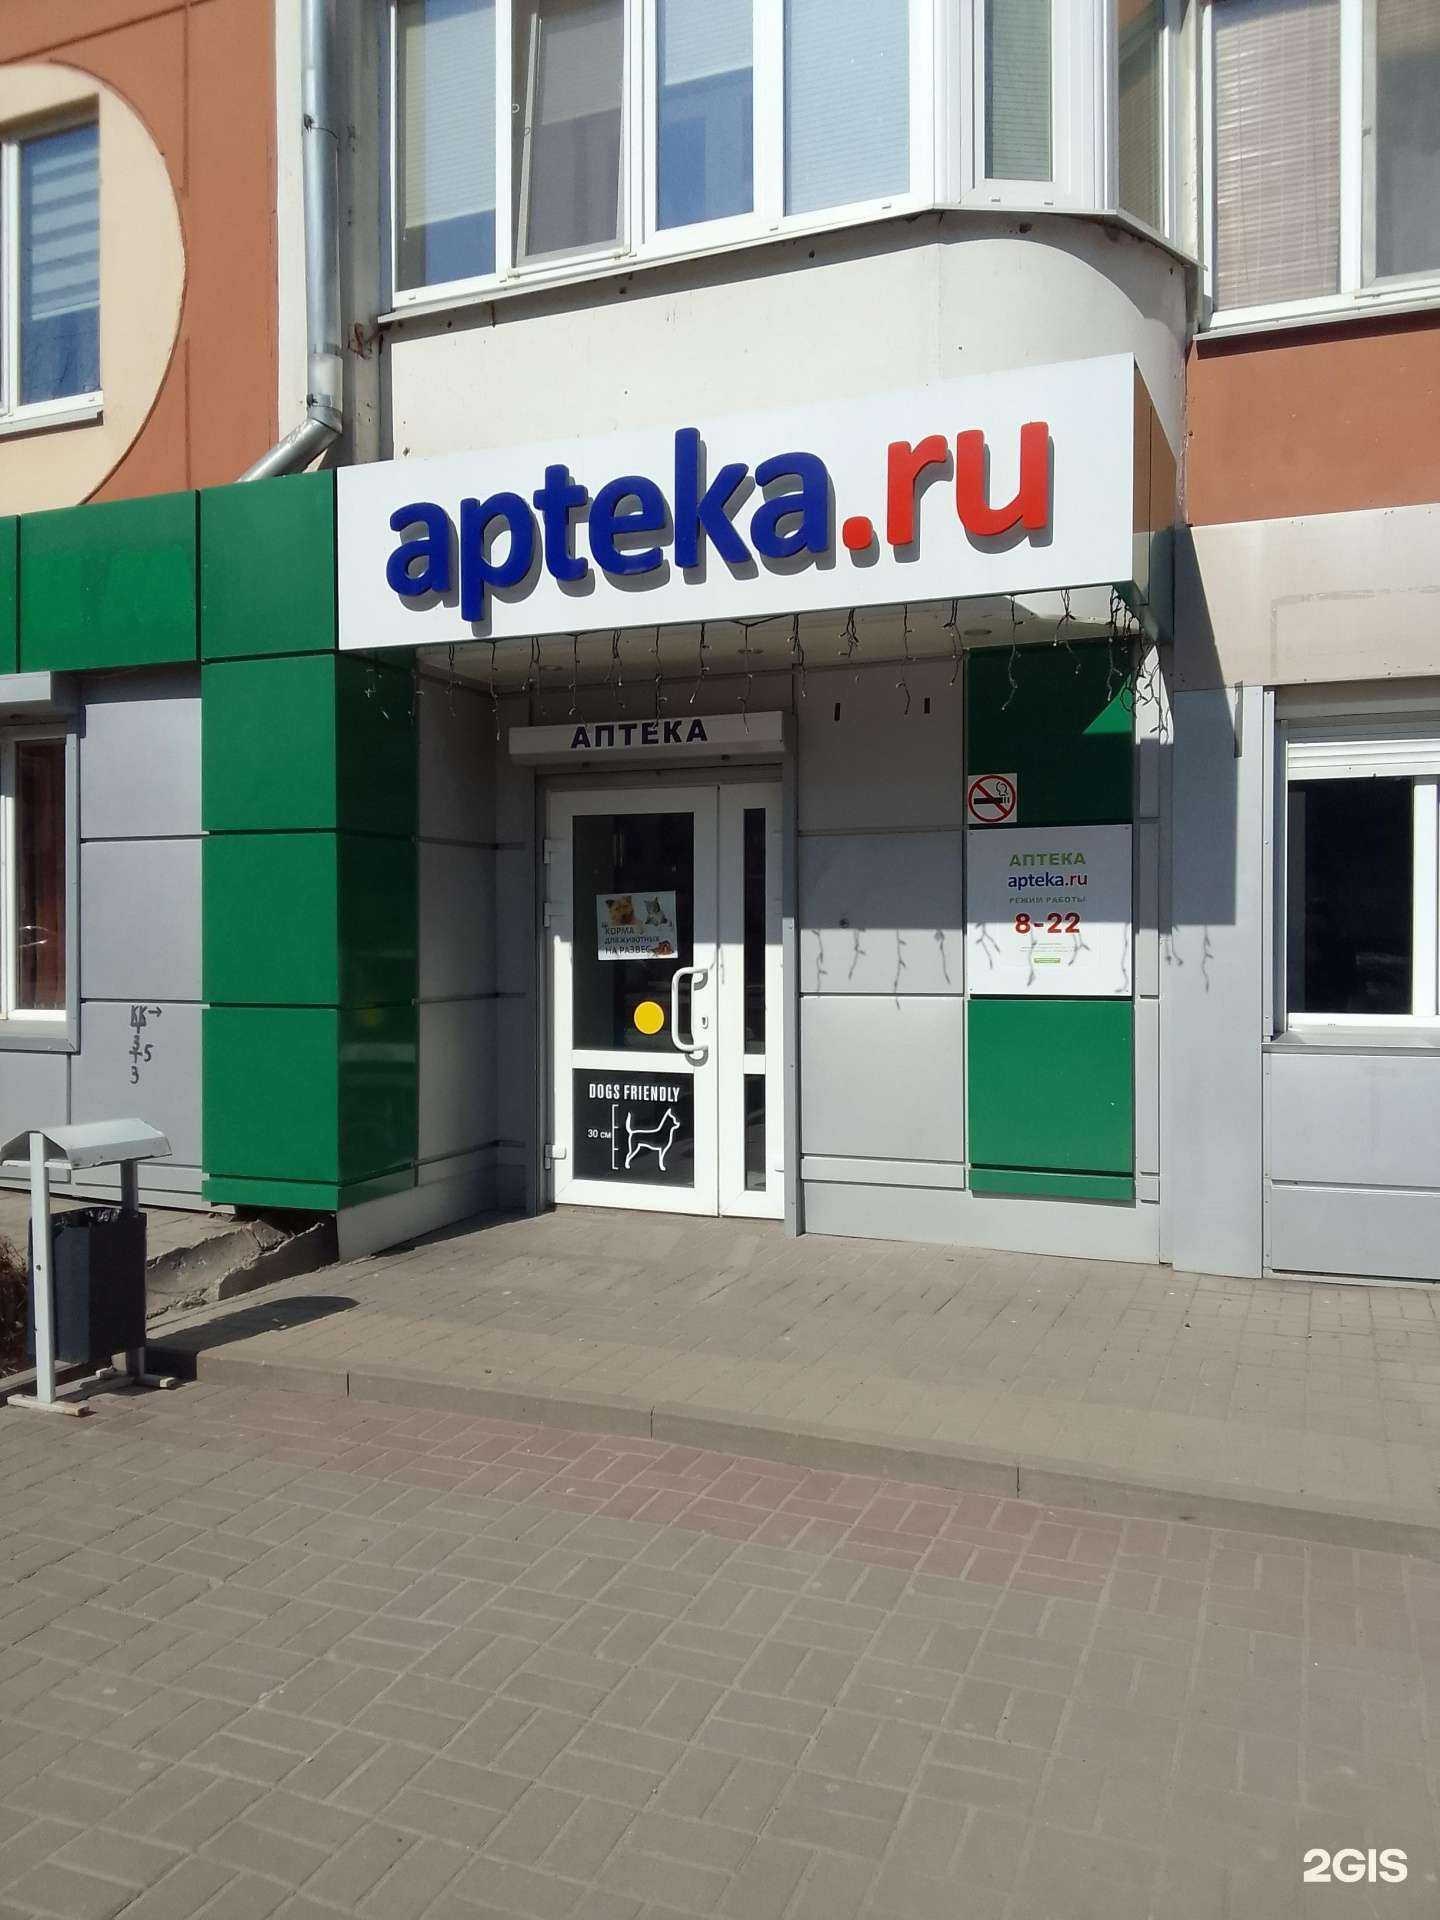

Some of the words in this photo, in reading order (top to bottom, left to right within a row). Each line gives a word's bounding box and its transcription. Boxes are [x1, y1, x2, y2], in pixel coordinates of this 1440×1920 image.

[386, 421, 1050, 622] apteka.ru
[570, 718, 708, 749] АПТЕКА
[1009, 852, 1086, 866] АПТЕКА
[1008, 871, 1088, 891] apteka.ru
[1015, 912, 1081, 934] 8-22
[589, 1083, 621, 1100] DOGS
[623, 1084, 680, 1102] FRIENDLY
[587, 1129, 599, 1138] 30
